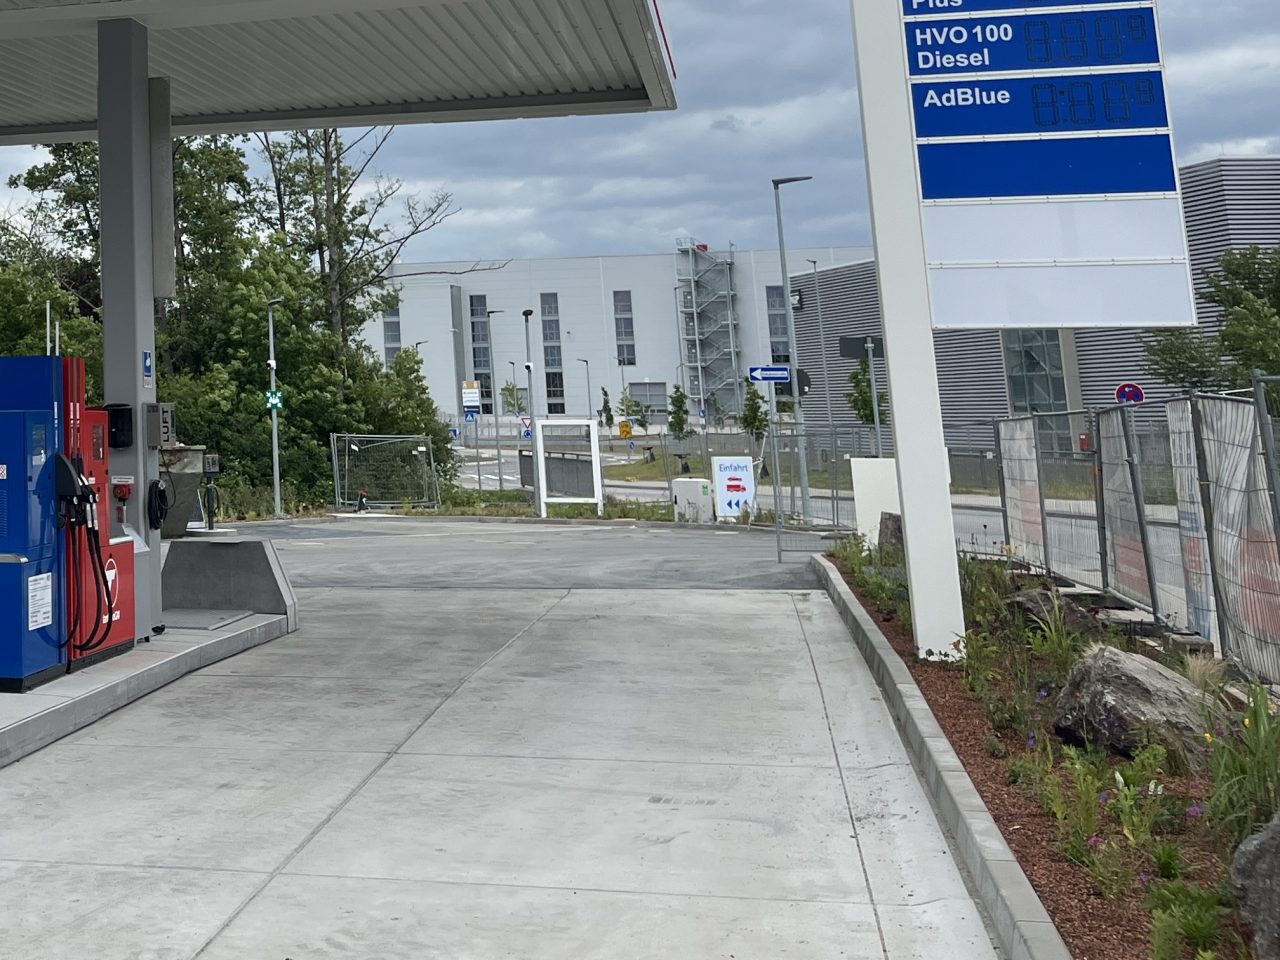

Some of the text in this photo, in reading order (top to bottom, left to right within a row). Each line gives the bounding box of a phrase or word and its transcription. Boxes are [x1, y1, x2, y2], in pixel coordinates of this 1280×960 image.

[915, 23, 1013, 46] HVO 100
[917, 48, 990, 69] Diesel
[923, 87, 1011, 108] AdBlue
[162, 408, 170, 443] LUFT
[719, 463, 749, 473] Einfahrt
